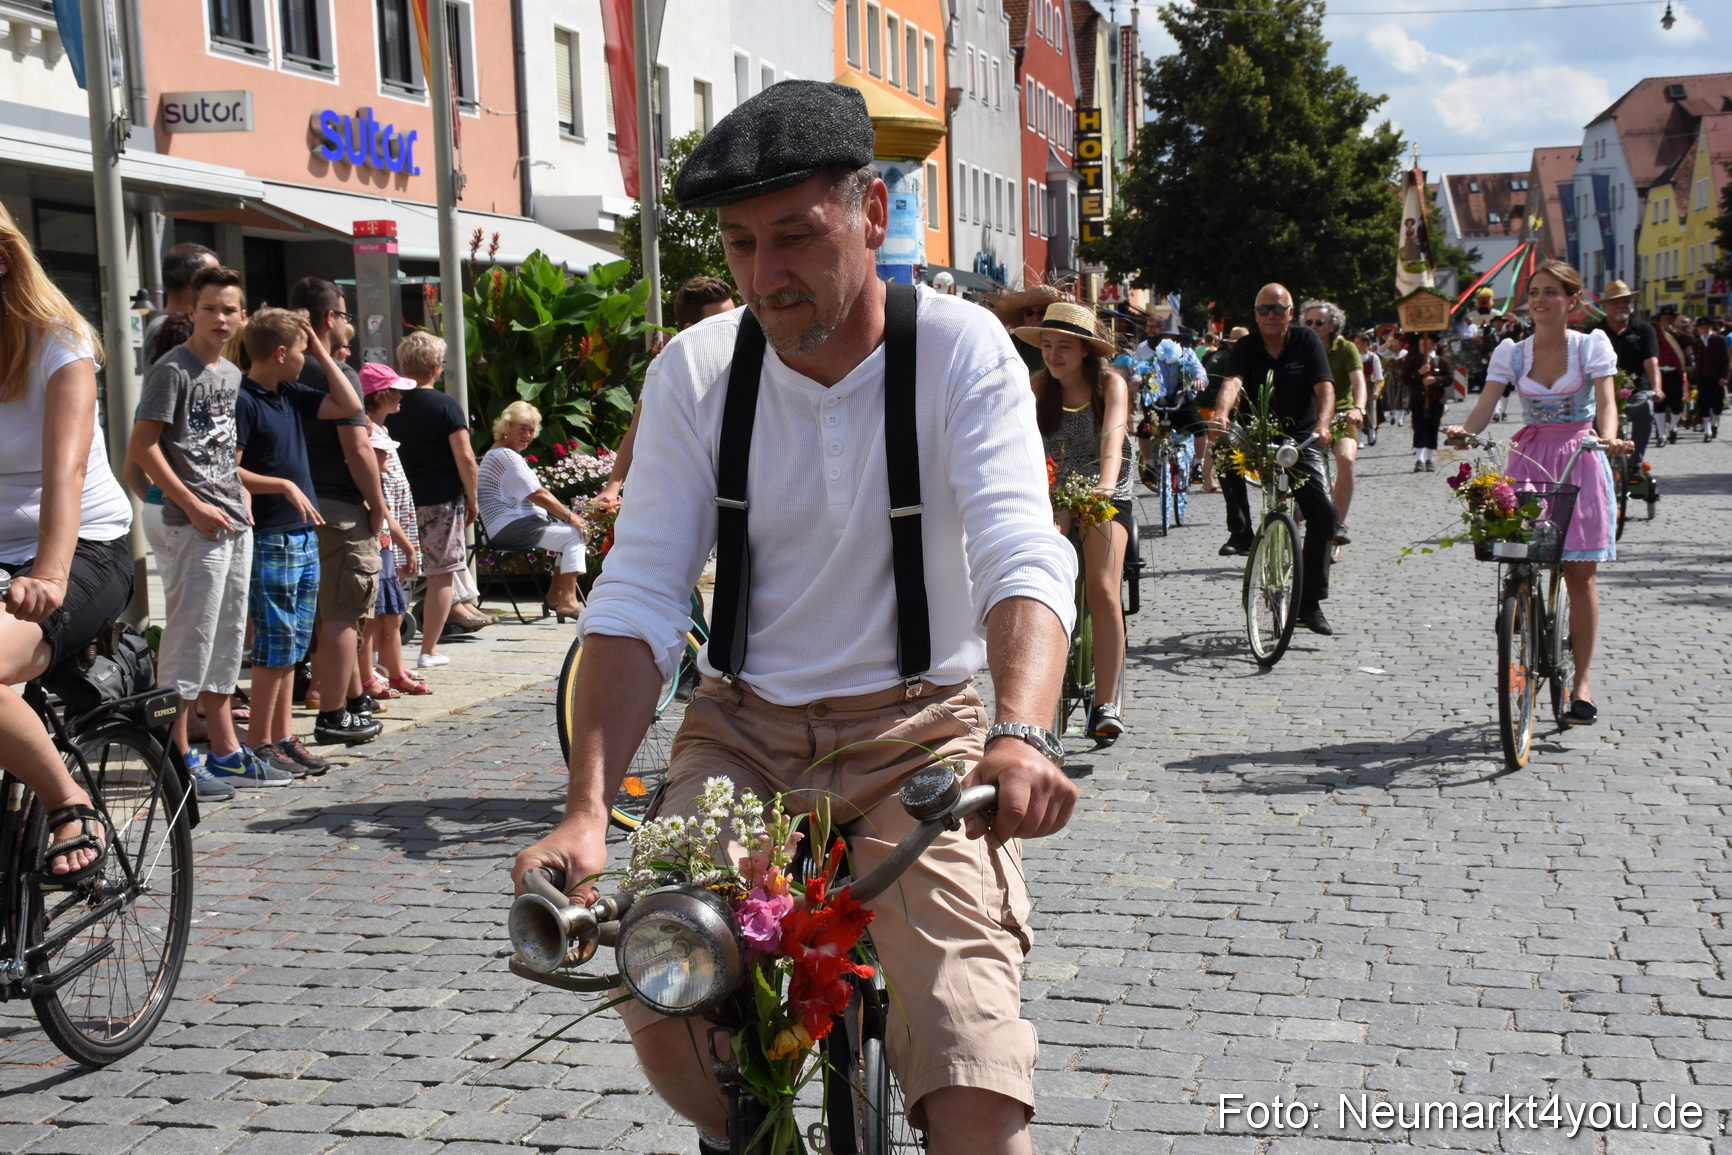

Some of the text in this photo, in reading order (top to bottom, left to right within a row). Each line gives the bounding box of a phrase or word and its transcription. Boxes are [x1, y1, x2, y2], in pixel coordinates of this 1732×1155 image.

[164, 97, 243, 124] sutor.
[320, 106, 420, 177] sutor.
[1079, 111, 1102, 243] HOTEL
[154, 706, 177, 718] EXPRESS
